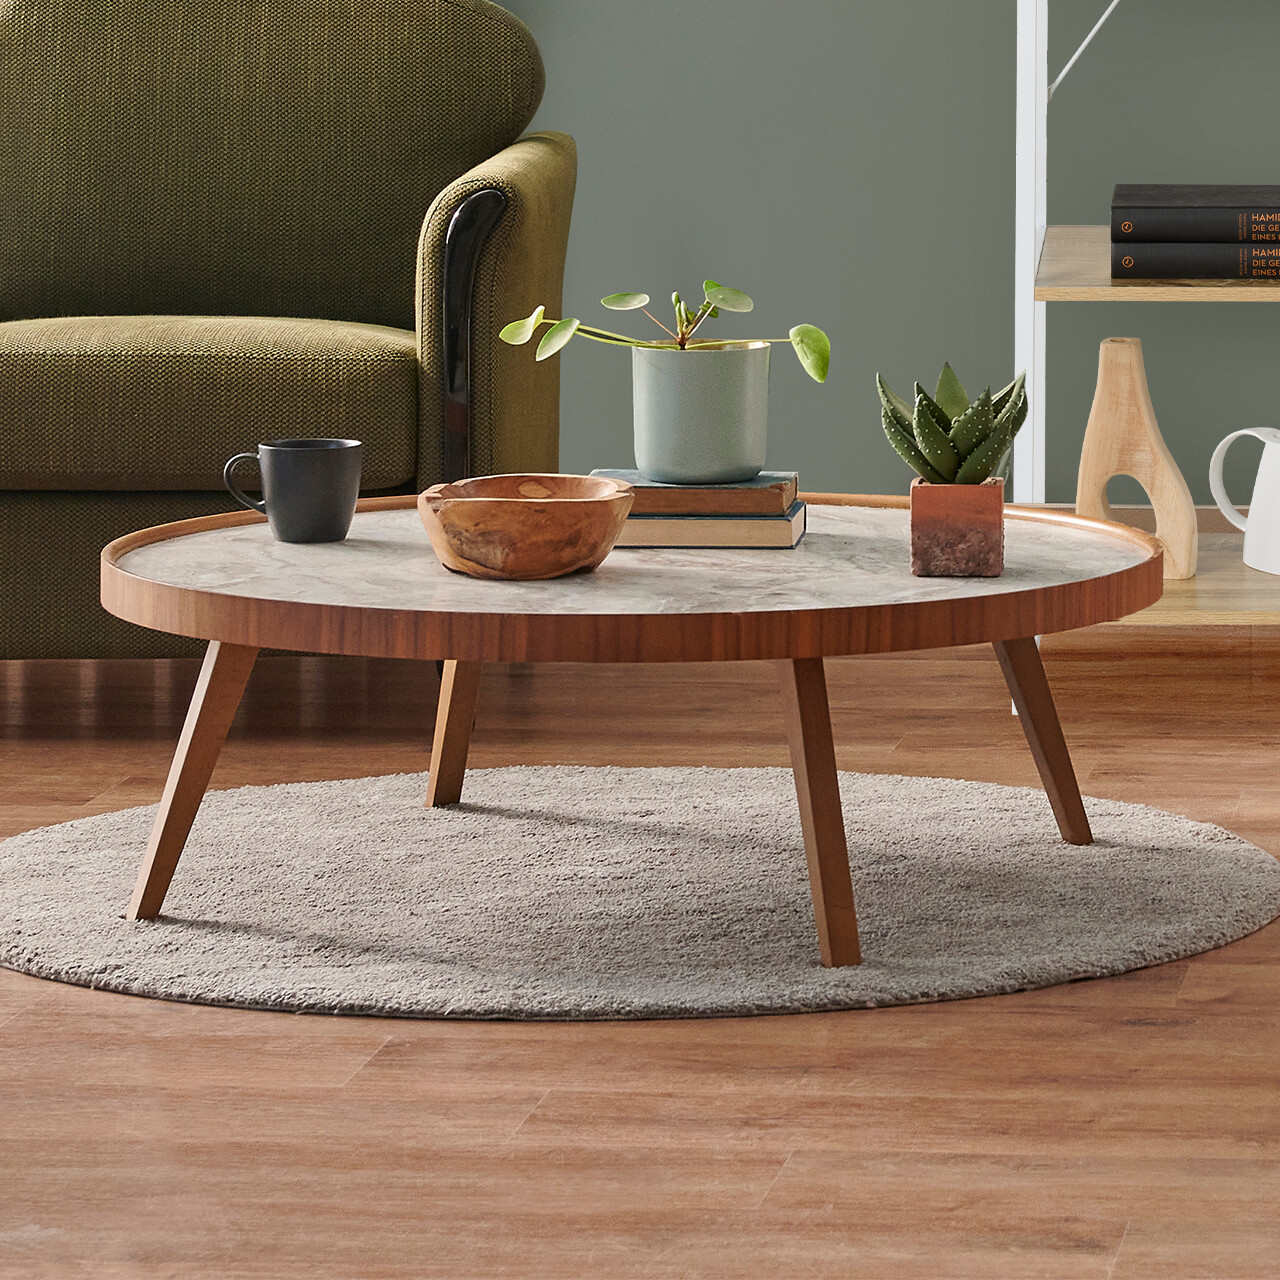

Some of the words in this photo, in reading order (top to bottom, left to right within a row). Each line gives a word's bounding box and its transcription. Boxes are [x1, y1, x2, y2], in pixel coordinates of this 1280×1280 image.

[1251, 224, 1266, 232] DIE
[1251, 233, 1276, 241] EINES
[1252, 259, 1267, 267] DIE
